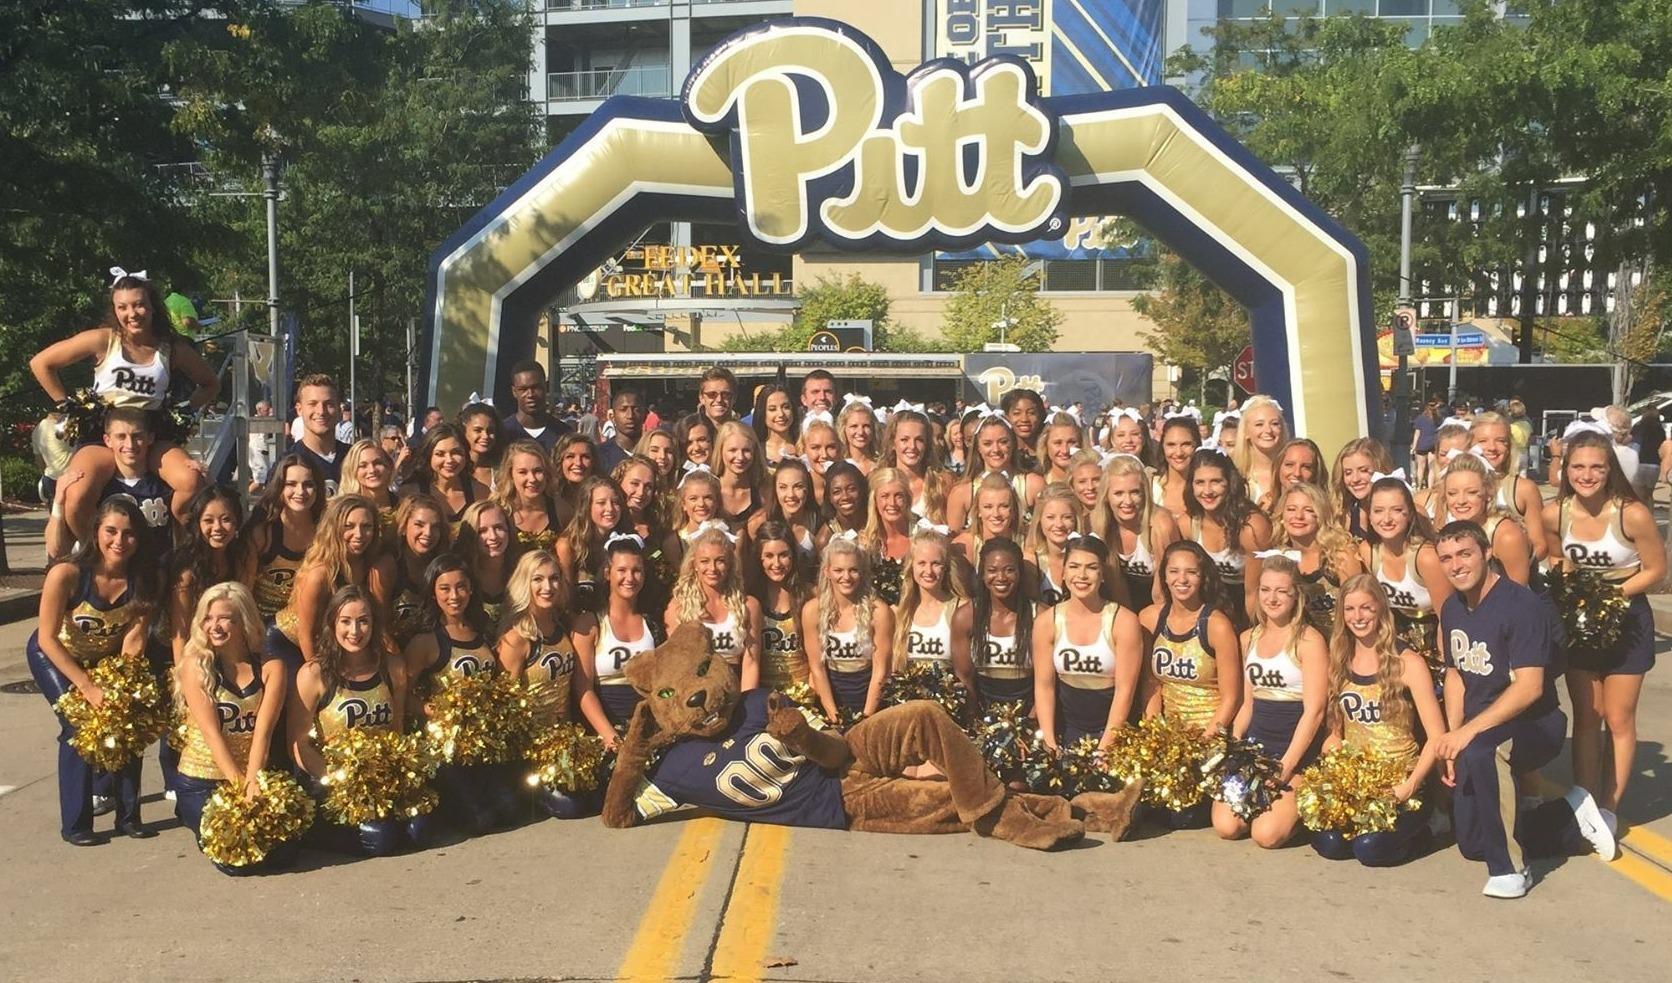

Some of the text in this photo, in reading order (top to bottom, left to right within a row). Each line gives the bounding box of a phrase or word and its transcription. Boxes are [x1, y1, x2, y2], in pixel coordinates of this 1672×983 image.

[687, 25, 1063, 245] Pitt
[644, 245, 741, 269] FEDEX
[606, 273, 694, 298] GREAT
[705, 272, 792, 295] HALL
[111, 367, 156, 395] Pitt
[1237, 361, 1254, 380] ST
[1565, 543, 1615, 567] Pitt
[907, 631, 944, 655] Pitt
[1058, 648, 1104, 674] Pitt
[1152, 646, 1199, 681] Pitt
[1246, 662, 1287, 689] Pitt
[337, 698, 393, 729] Pitt
